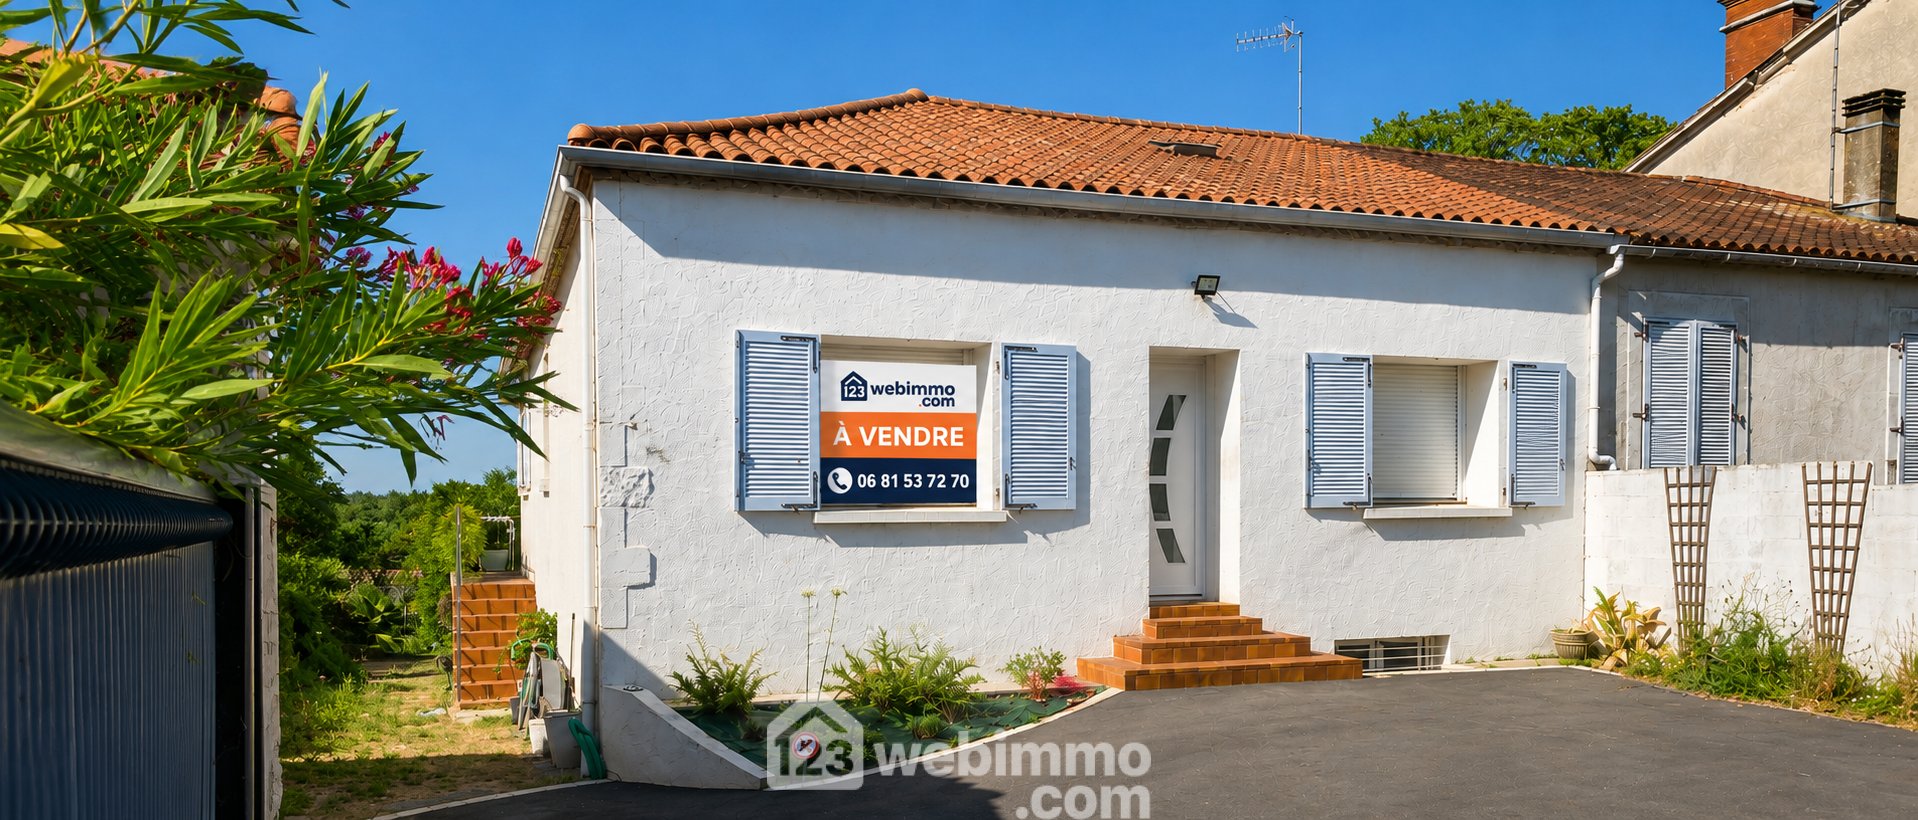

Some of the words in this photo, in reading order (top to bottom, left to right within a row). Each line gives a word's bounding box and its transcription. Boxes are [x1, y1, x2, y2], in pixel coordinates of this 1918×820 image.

[844, 386, 865, 398] 123
[870, 381, 955, 396] webimmo
[919, 397, 955, 407] .com
[833, 420, 852, 446] À
[859, 426, 964, 447] VENDRE
[857, 474, 876, 488] 06
[881, 474, 898, 488] 81
[903, 474, 923, 488] 53
[926, 474, 947, 488] 72
[951, 474, 970, 488] 70
